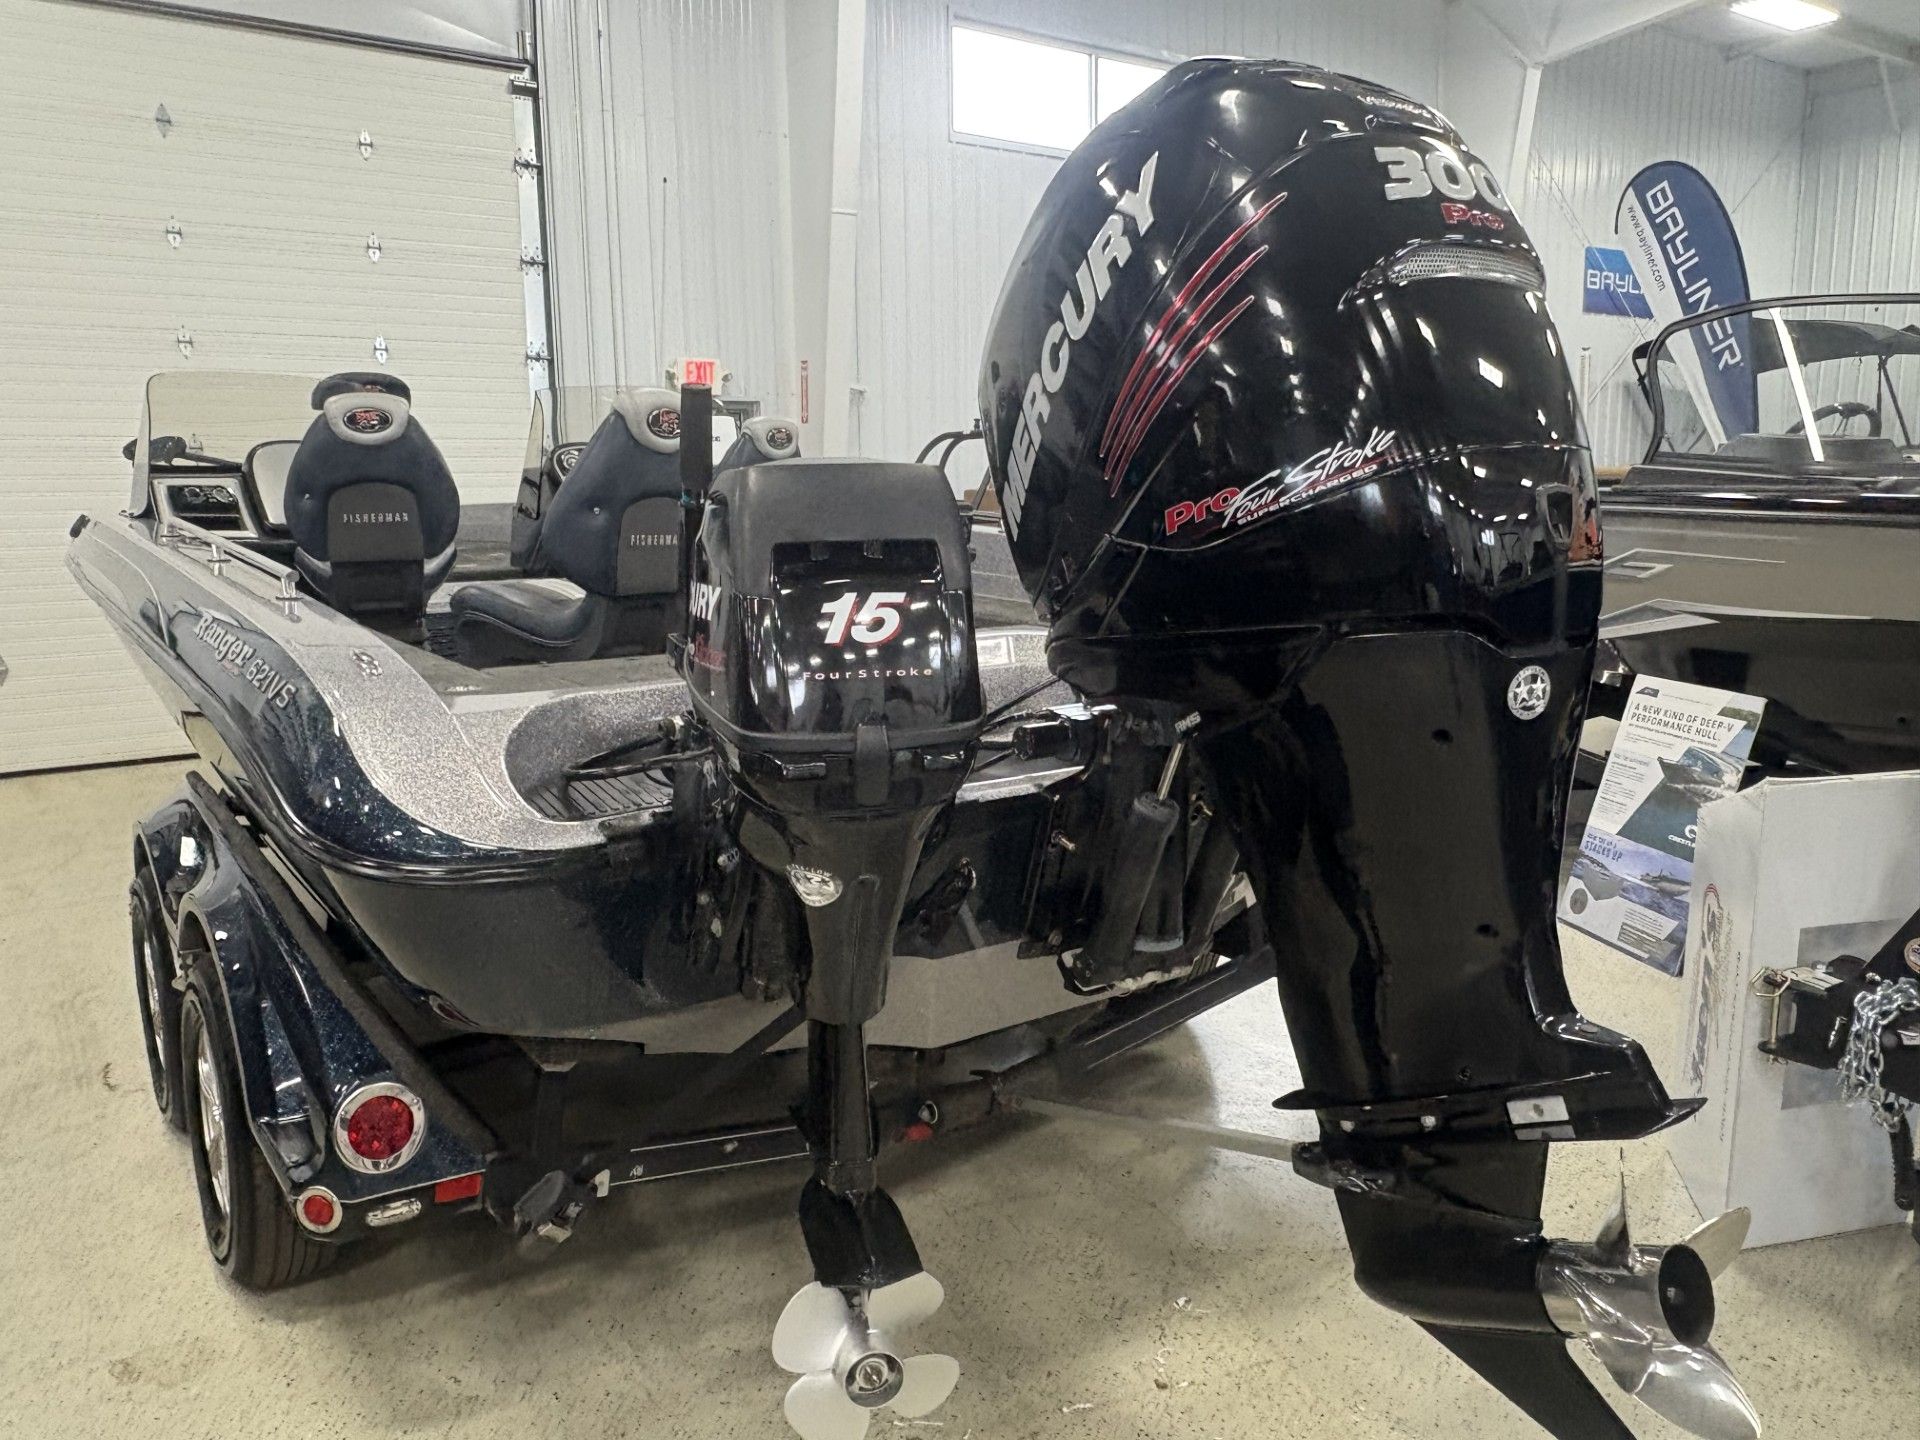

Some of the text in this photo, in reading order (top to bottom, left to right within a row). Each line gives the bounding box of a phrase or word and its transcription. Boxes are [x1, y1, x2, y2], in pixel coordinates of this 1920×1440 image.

[1374, 147, 1509, 211] 300
[1440, 202, 1504, 230] Pro
[1627, 206, 1667, 292] www.bayliner.com
[1586, 269, 1643, 295] BAYL
[686, 361, 715, 384] EXIT
[1003, 151, 1159, 543] MERCURY
[1164, 487, 1242, 536] Pro
[1284, 426, 1396, 497] Stroke
[1237, 465, 1378, 526] SUPERCHARGED
[343, 511, 408, 524] FISHERMAN
[820, 591, 911, 648] 15
[194, 610, 297, 709] Ranger 621VS
[1631, 712, 1692, 734] PERFORMANCE
[1634, 703, 1735, 733] A NEW KIND OF DEEP-V
